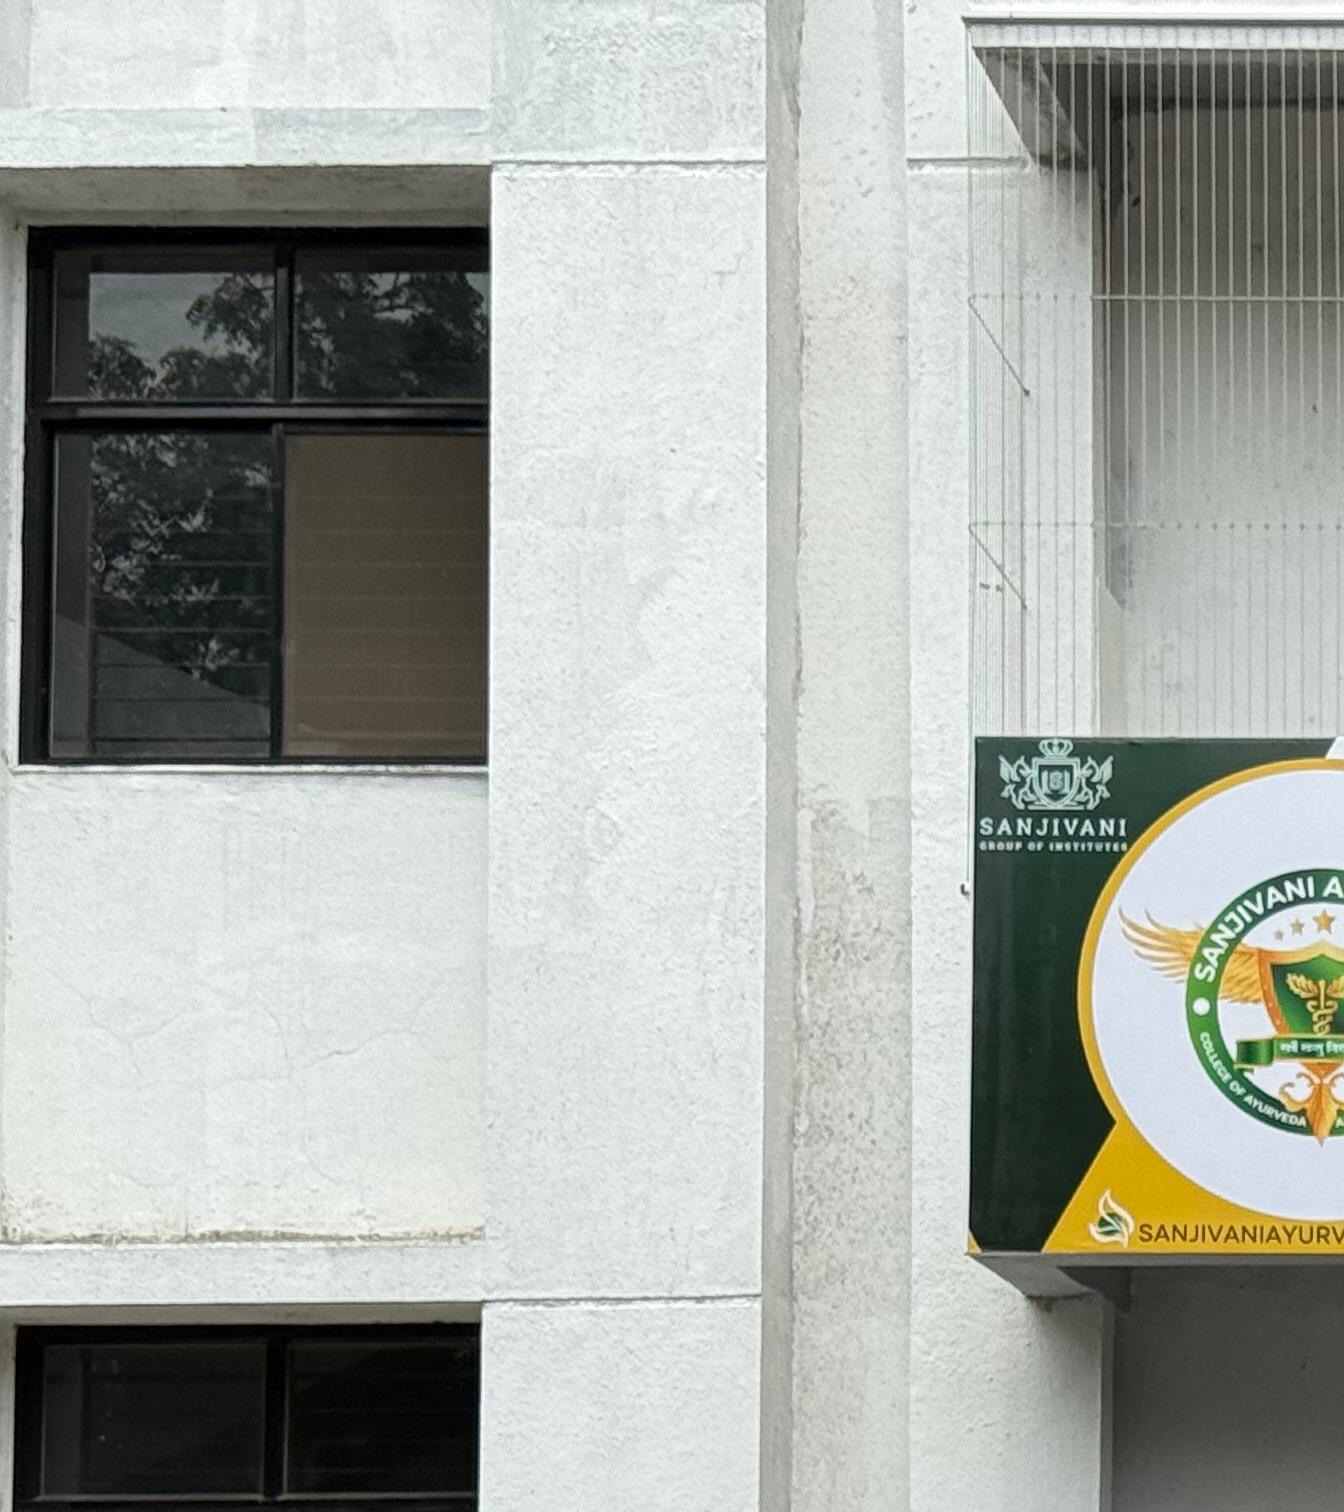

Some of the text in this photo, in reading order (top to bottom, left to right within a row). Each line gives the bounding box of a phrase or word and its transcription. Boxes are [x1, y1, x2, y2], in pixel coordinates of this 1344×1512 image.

[979, 816, 1127, 837] SANJIVANI
[979, 840, 1023, 851] GROUP
[1027, 841, 1044, 851] OF
[1194, 876, 1315, 983] SANJIVANI
[1200, 1031, 1307, 1127] COLLEGE OF AYURVEDA
